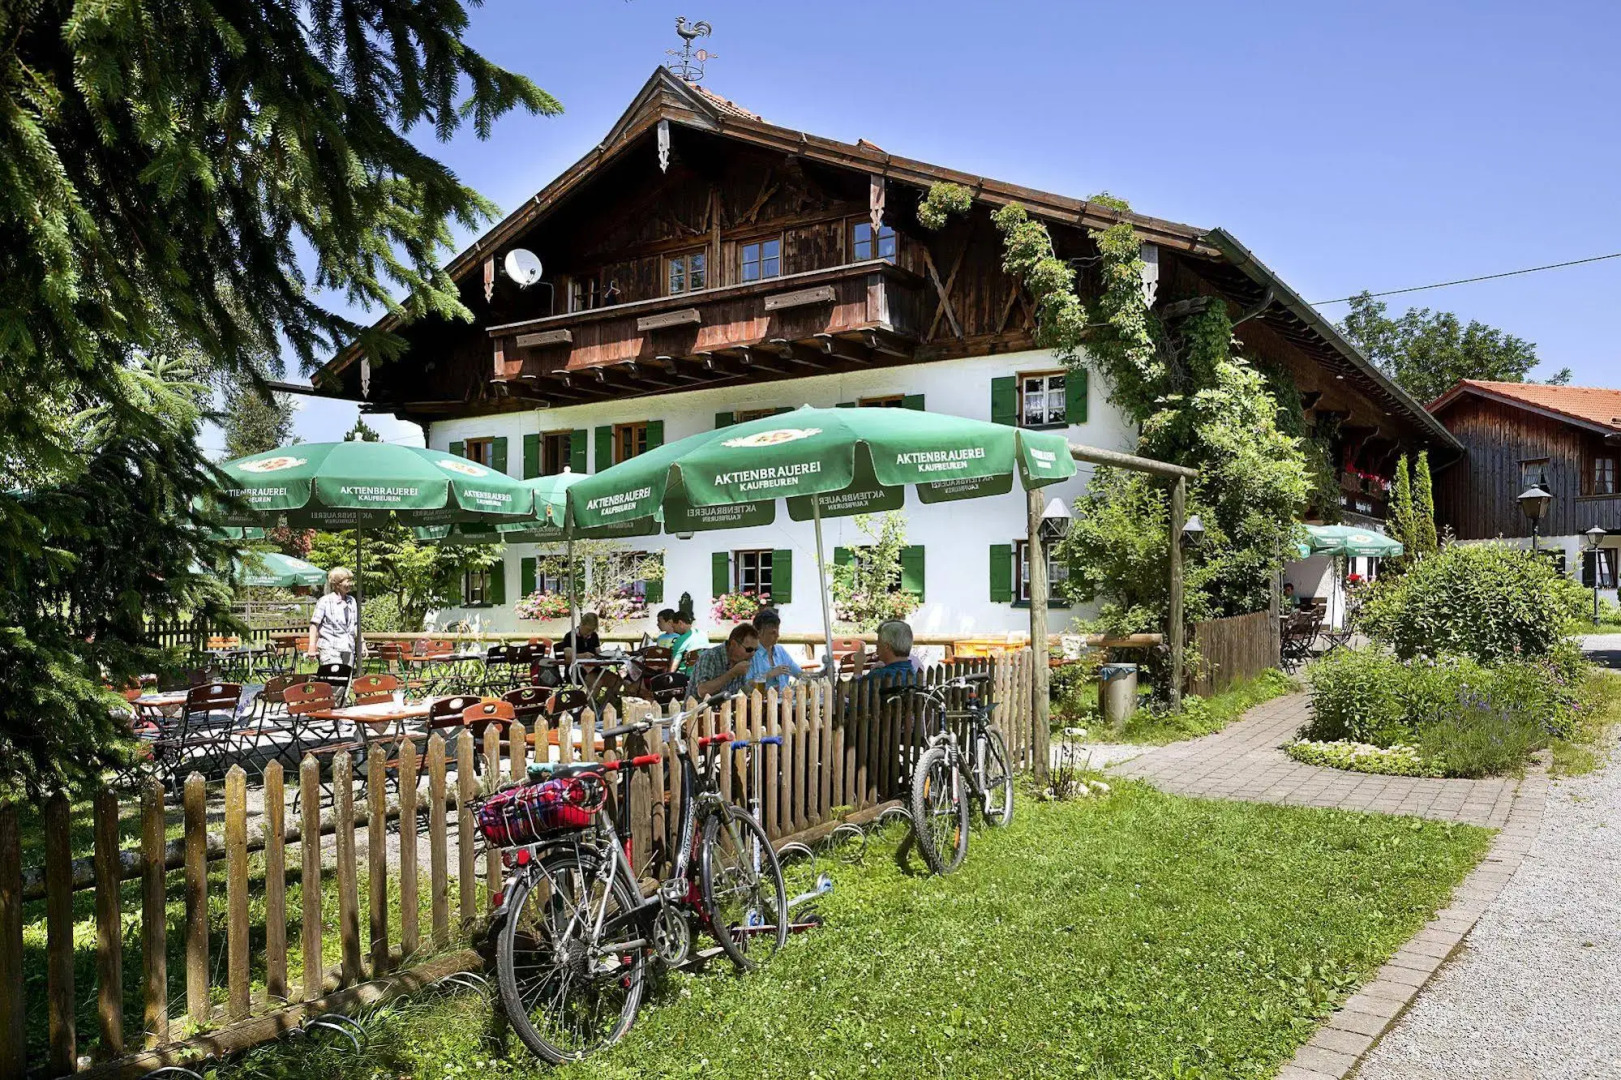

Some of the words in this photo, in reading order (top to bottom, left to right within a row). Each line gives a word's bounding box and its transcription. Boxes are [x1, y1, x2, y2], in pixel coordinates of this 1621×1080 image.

[896, 447, 985, 465] AKTIENBRAUEREI
[714, 461, 821, 486] AKTIENBRAUEREI
[918, 460, 968, 473] KAUFBEUREN
[340, 486, 418, 496] AKTIENBRAUEREI
[739, 477, 799, 492] KAUFBEUREN
[586, 487, 651, 511] AKTIENBRAUEREI
[601, 502, 637, 516] KAUFBEUREN
